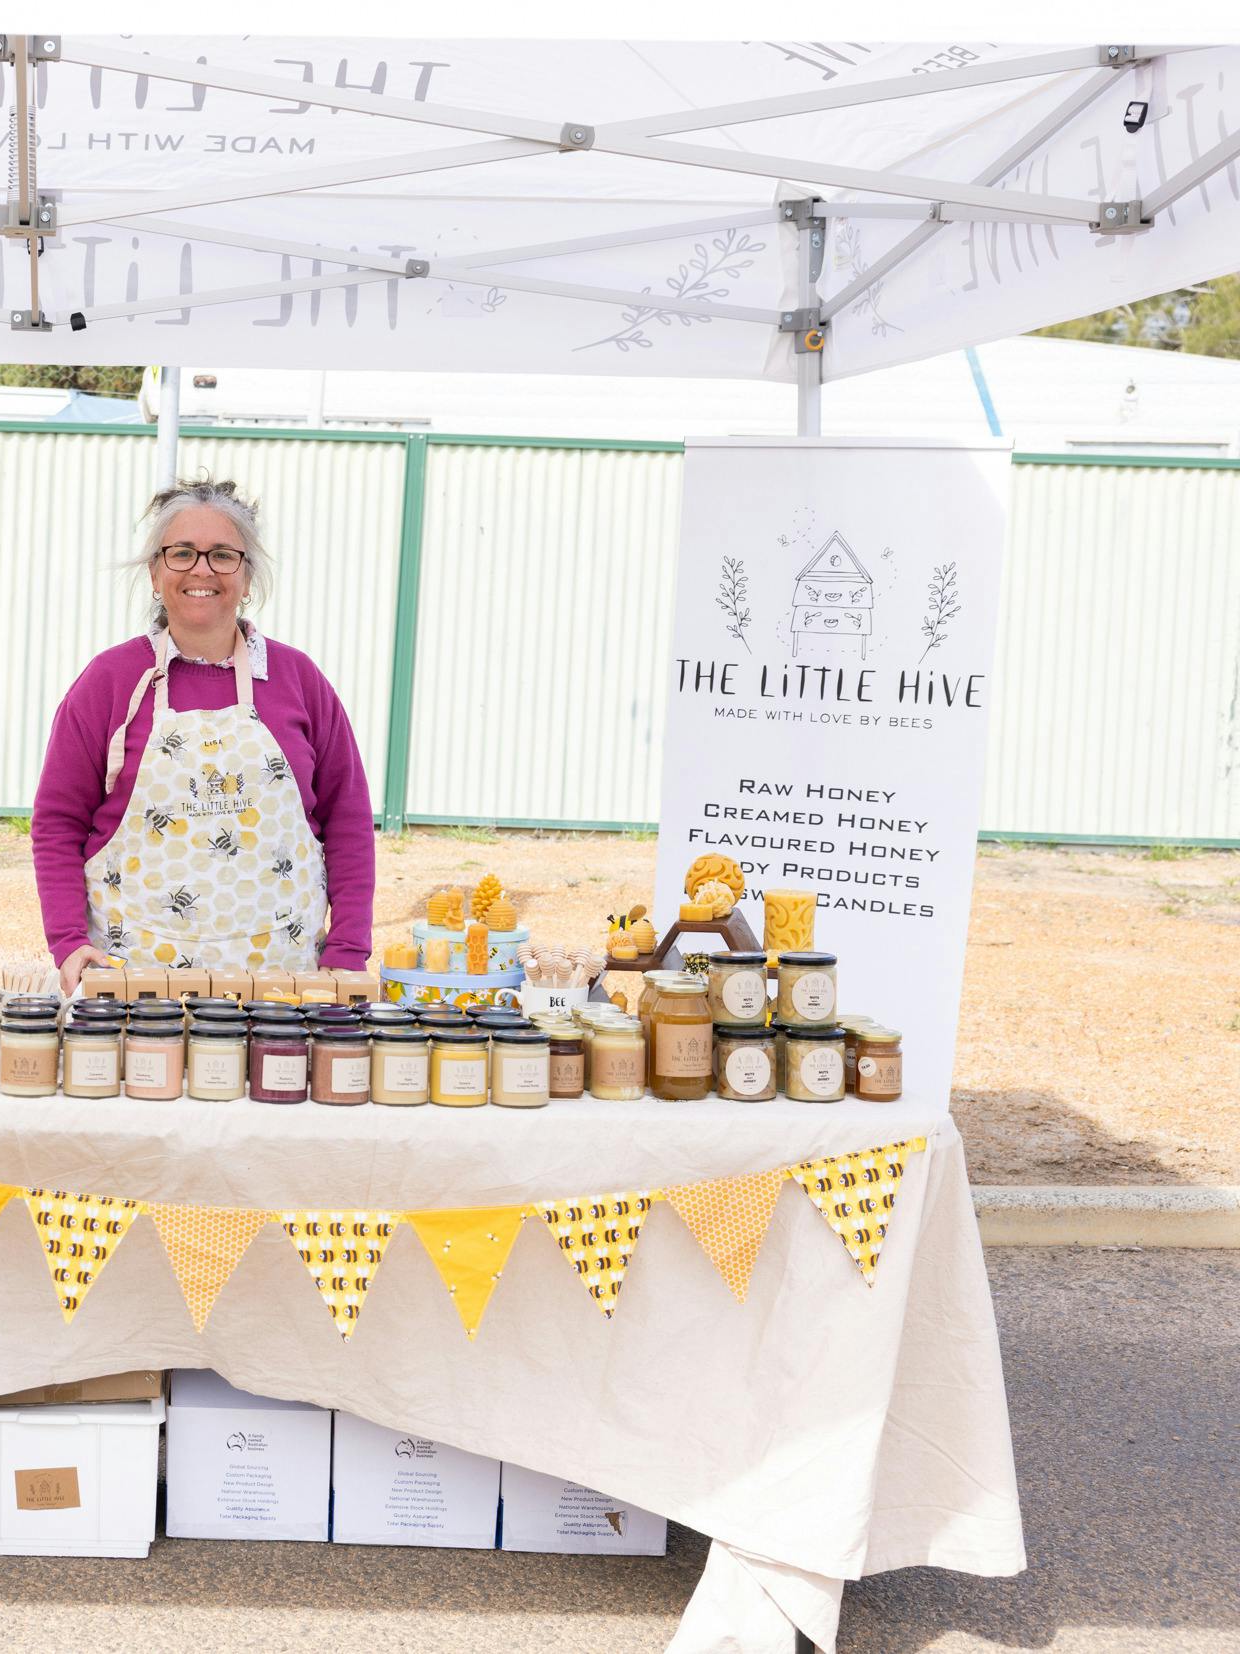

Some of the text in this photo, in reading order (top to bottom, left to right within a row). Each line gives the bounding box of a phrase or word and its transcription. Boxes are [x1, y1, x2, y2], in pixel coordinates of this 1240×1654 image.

[676, 659, 985, 708] THE LiTTLE HiVE
[714, 707, 933, 729] MADE WITH LOVE BY BEES
[739, 779, 896, 803] RAW HONEY
[704, 803, 928, 834] CREAMED HONEY
[688, 828, 940, 862] FLAVOURED HONEY
[782, 863, 920, 889] PRODUCTS
[816, 893, 934, 918] CANDLES
[550, 996, 566, 1007] BEE
